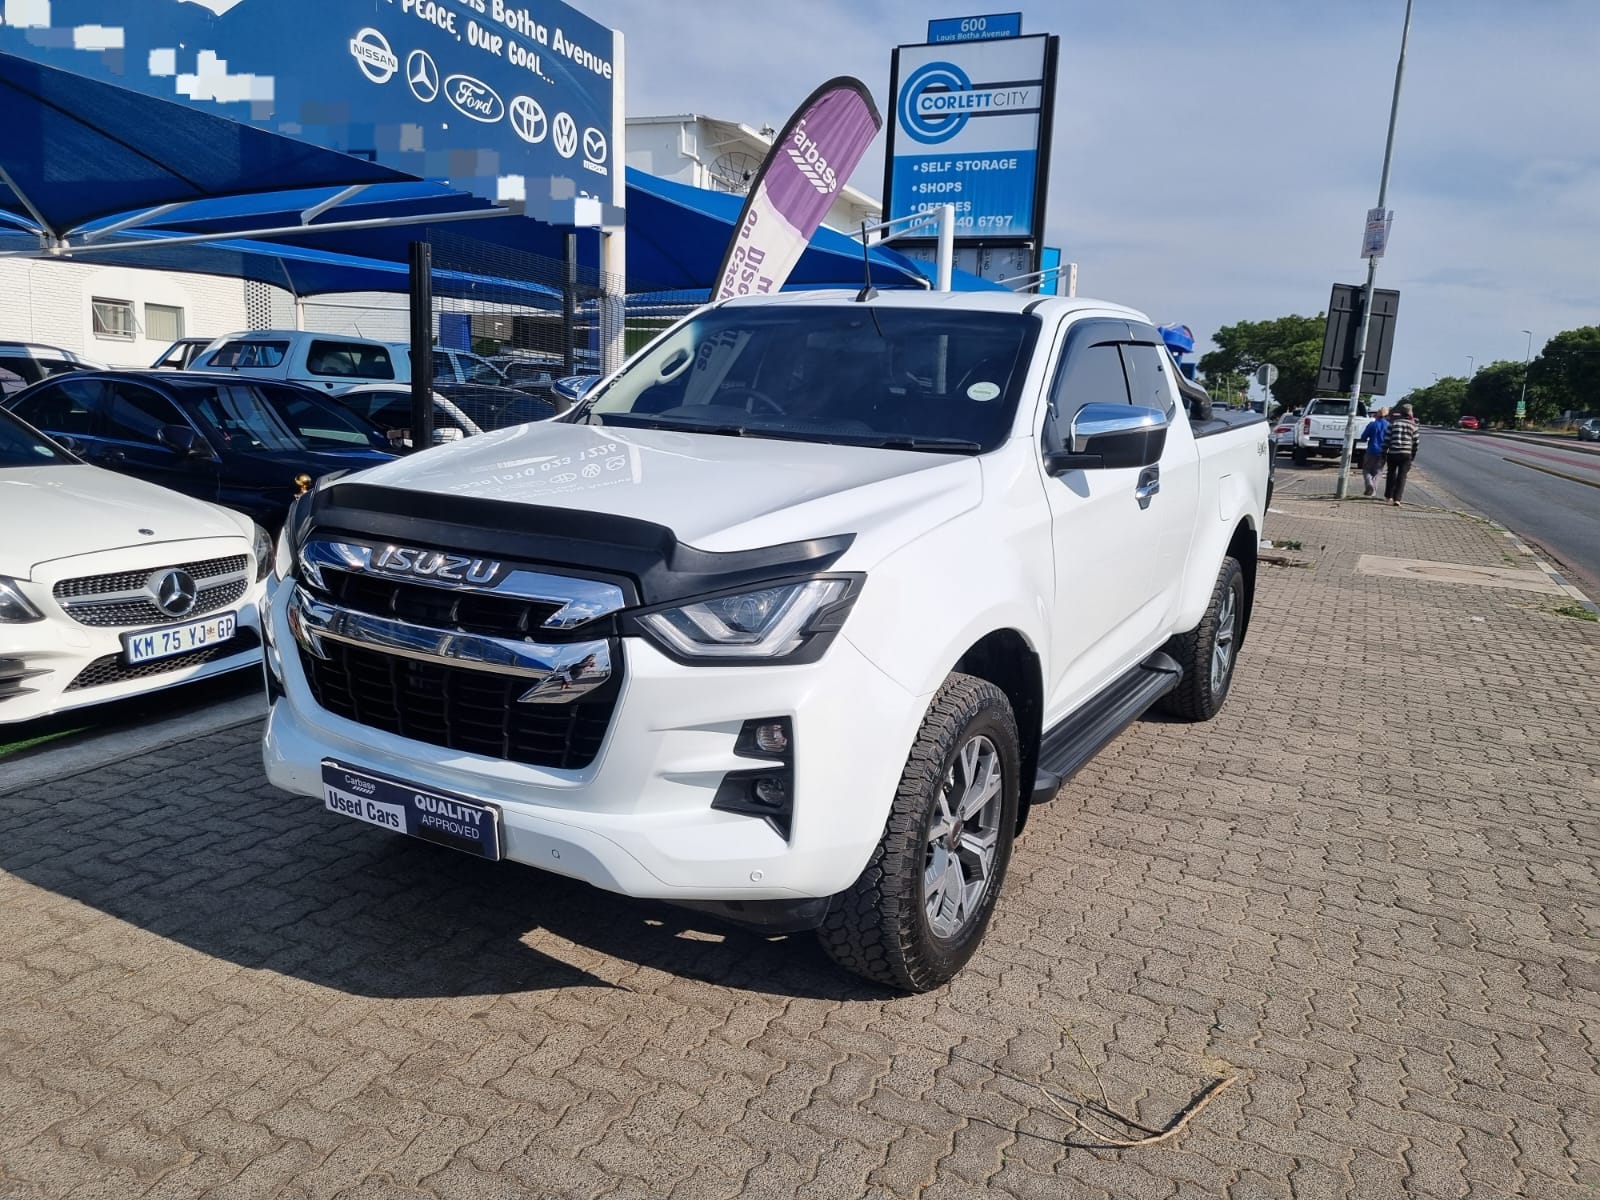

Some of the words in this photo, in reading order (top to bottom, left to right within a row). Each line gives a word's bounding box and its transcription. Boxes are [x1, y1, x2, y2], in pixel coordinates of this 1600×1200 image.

[936, 34, 956, 42] Louis
[957, 31, 980, 40] Botha
[981, 30, 1010, 39] Avenue
[961, 17, 986, 32] 600
[467, 20, 503, 57] OUR
[492, 0, 548, 46] Botha
[552, 28, 613, 80] Avenue
[353, 43, 396, 68] NISSAN
[456, 81, 494, 116] Ford
[920, 161, 952, 173] SELF
[955, 158, 1017, 171] STORAGE
[919, 181, 962, 193] SHOPS
[978, 215, 1013, 227] 6797
[377, 545, 500, 583] ISUZU
[133, 636, 154, 659] KM
[162, 631, 181, 652] 75
[189, 625, 206, 645] YJ
[217, 618, 233, 638] GP
[345, 774, 376, 791] Carbase
[329, 790, 363, 817] Used
[367, 800, 400, 828] Cars
[414, 794, 483, 825] QUALITY
[422, 814, 480, 840] APPROVED
